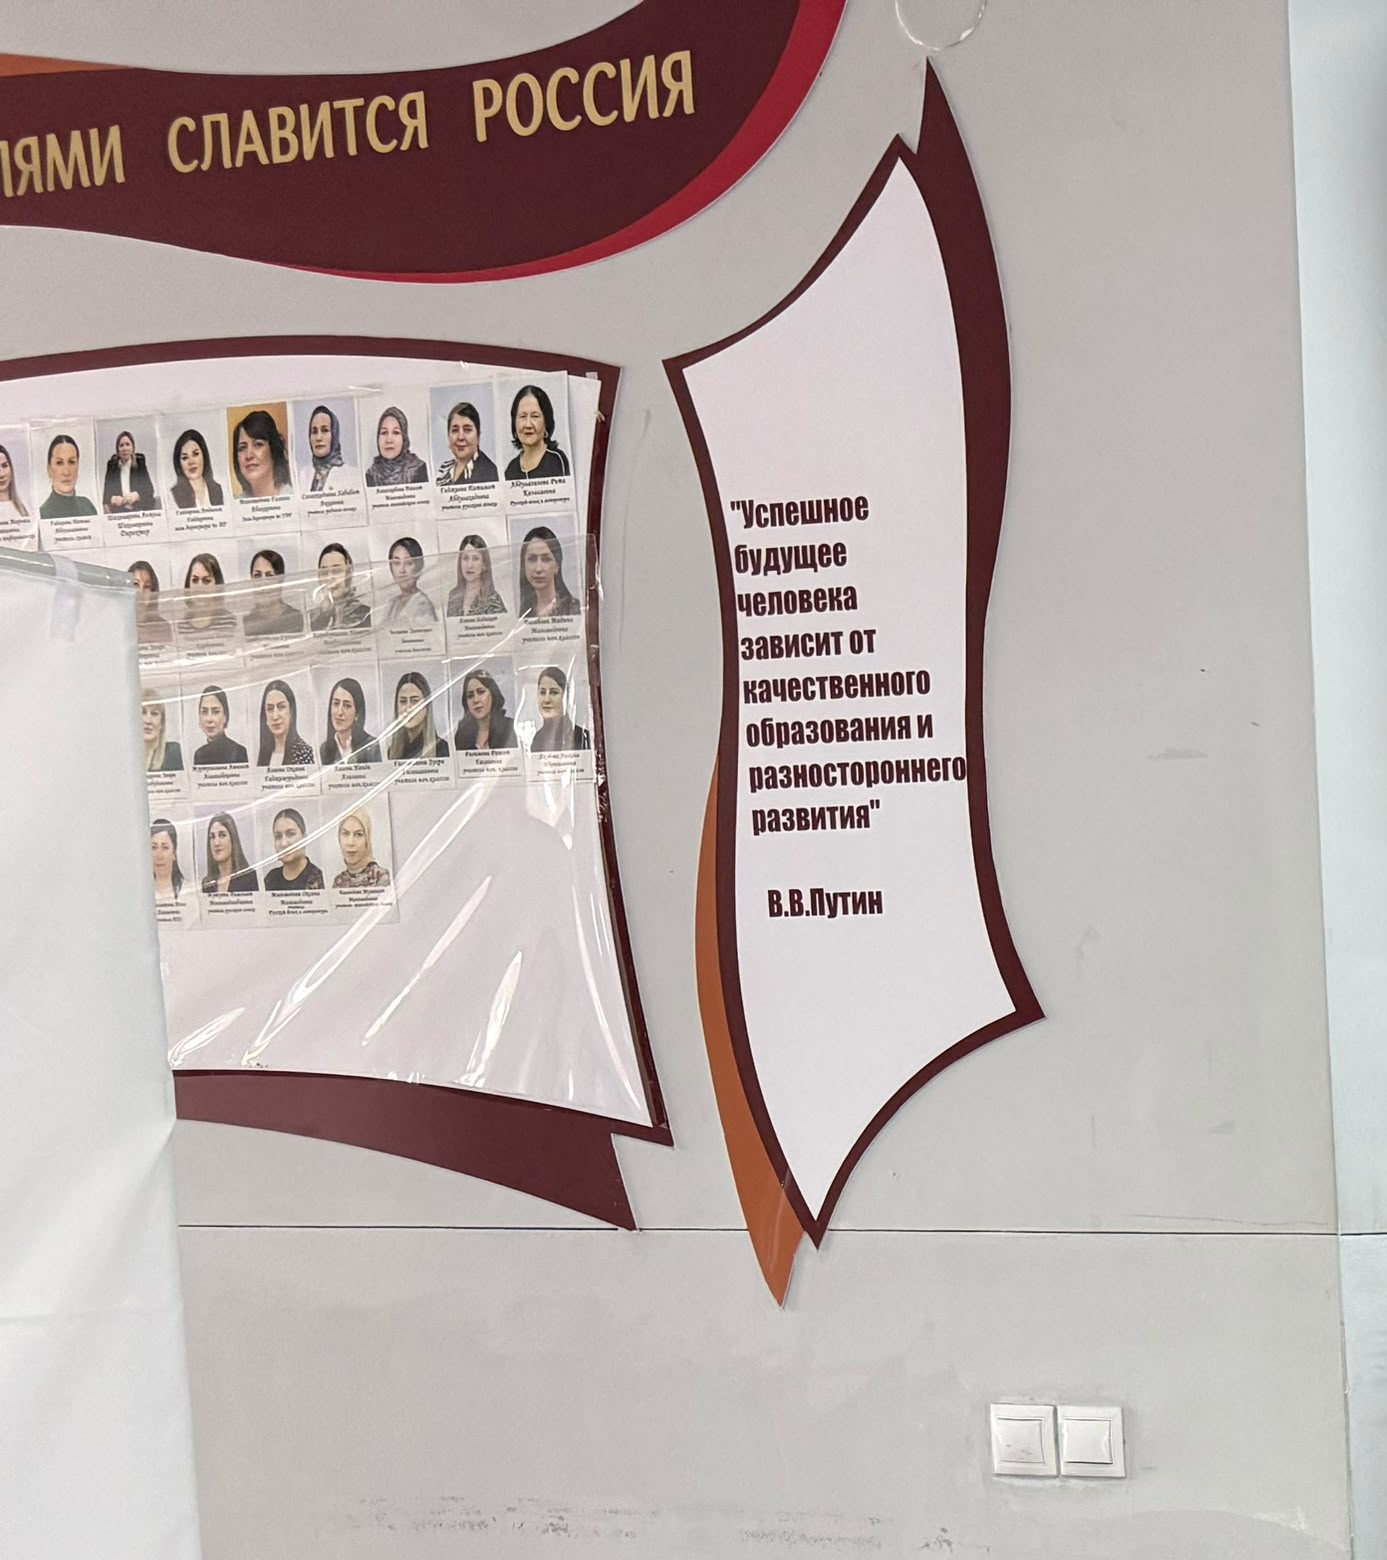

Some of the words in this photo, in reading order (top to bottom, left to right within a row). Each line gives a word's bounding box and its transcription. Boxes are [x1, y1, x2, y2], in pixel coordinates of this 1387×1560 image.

[167, 90, 429, 174] СЛАВИТСЯ
[472, 49, 696, 143] РОССИЯ
[730, 495, 870, 529] "Успешное
[734, 541, 847, 576] будущее
[737, 585, 858, 617] человека
[740, 630, 844, 661] зависит
[849, 628, 877, 655] от
[743, 669, 931, 704] качественного
[746, 715, 911, 749] образования
[916, 713, 934, 739] и
[749, 756, 966, 793] разностороннего
[752, 799, 880, 836] развития"
[767, 887, 883, 919] В.В.Путин
